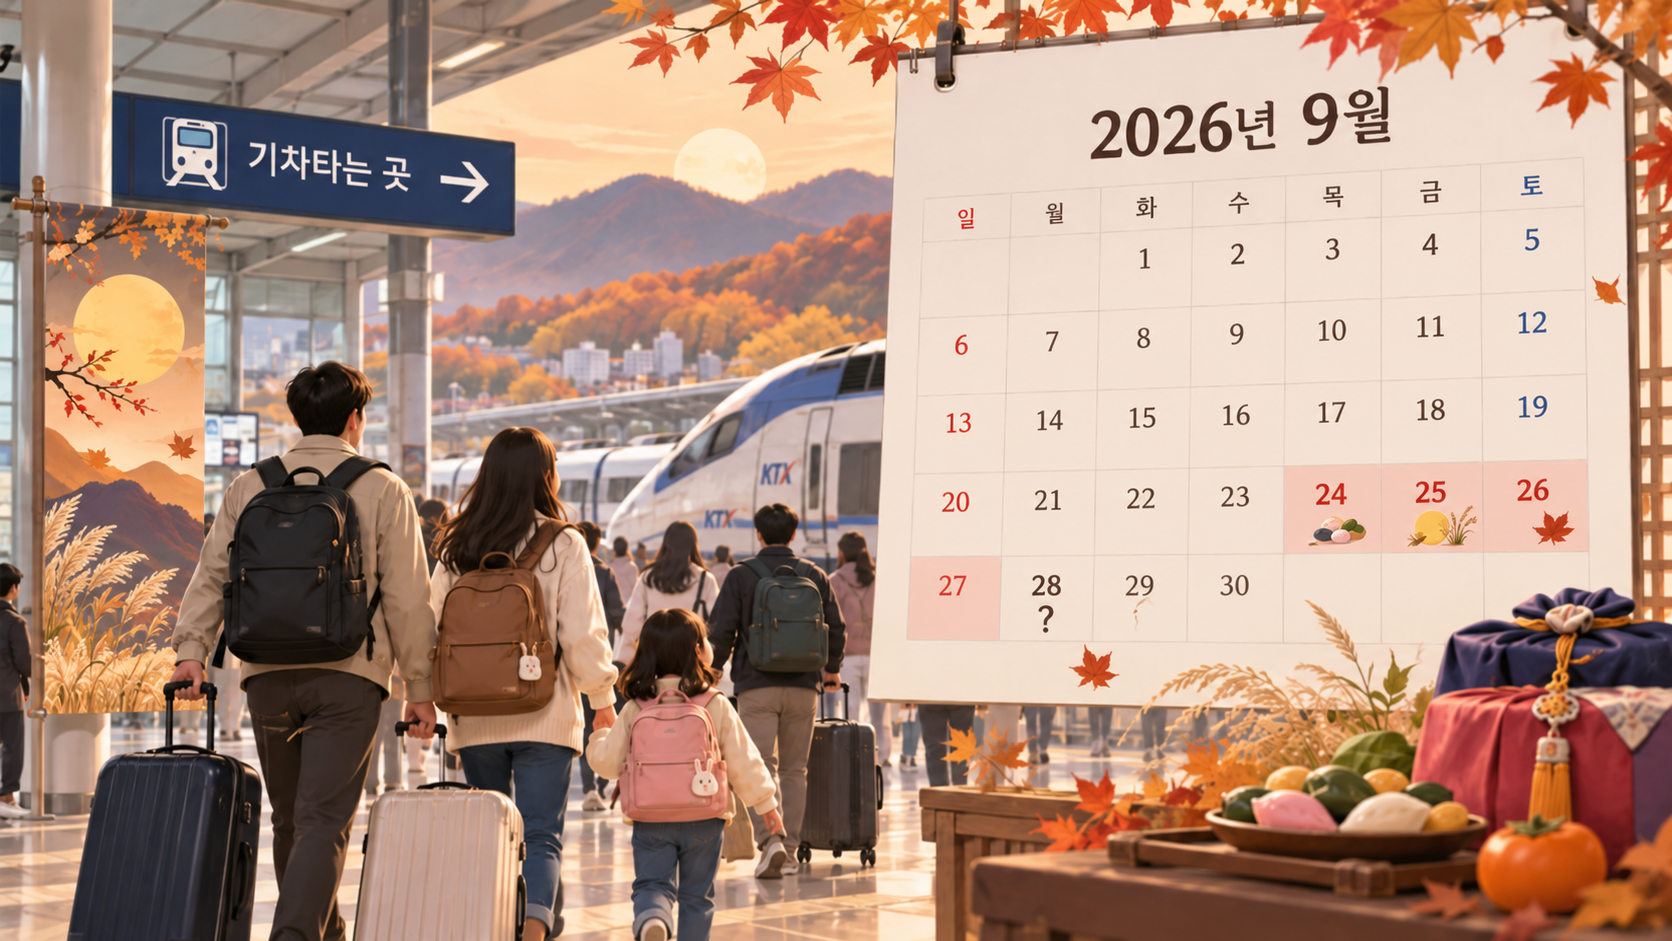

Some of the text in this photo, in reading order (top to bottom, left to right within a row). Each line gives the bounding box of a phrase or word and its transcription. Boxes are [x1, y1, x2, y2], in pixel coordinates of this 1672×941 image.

[1090, 85, 1392, 160] 2026년 9월
[248, 142, 412, 192] 기차타는 곳
[957, 174, 1544, 230] 일 월 화 수 목 금 토
[1139, 227, 1540, 270] 1 2 3 4 5
[954, 310, 1547, 356] 6 7 8 9 10 11 12
[946, 395, 1548, 434] 13 14 15 16 17 18 19
[760, 459, 797, 485] KTX
[941, 478, 1550, 513] 20 21 22 23 24 25 26
[705, 509, 736, 529] KTX
[938, 574, 1250, 597] 27 28 29 30
[1037, 604, 1055, 634] ?
